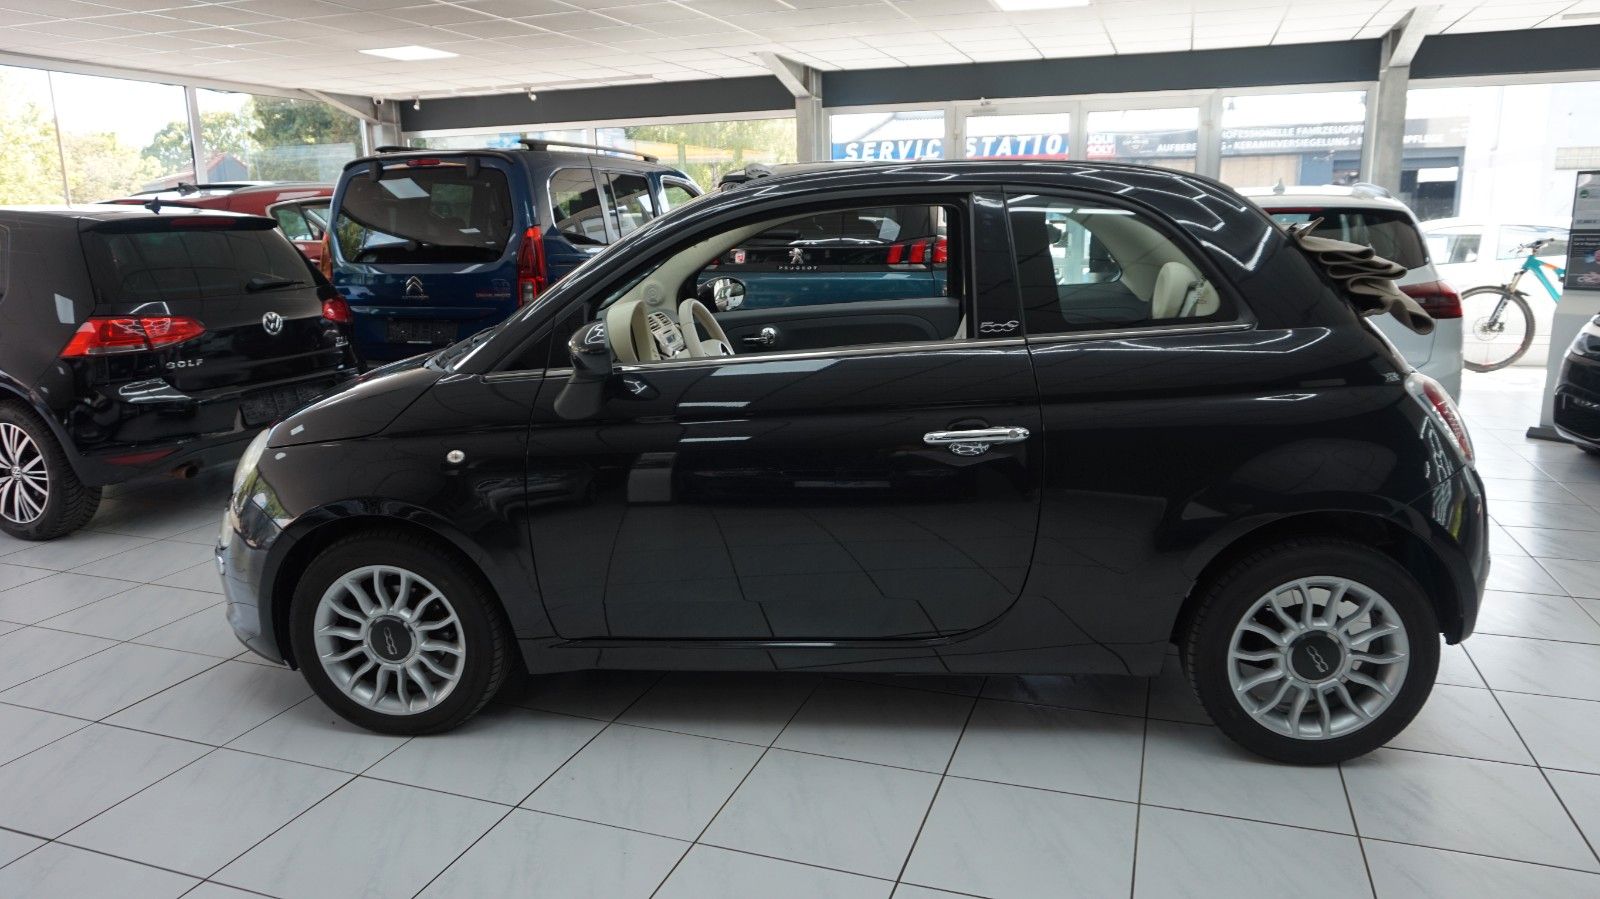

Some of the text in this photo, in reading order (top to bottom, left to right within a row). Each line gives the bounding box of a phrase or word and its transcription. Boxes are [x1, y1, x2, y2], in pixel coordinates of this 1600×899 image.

[844, 134, 1069, 160] SERVIC STATIO
[165, 358, 204, 370] GOLF
